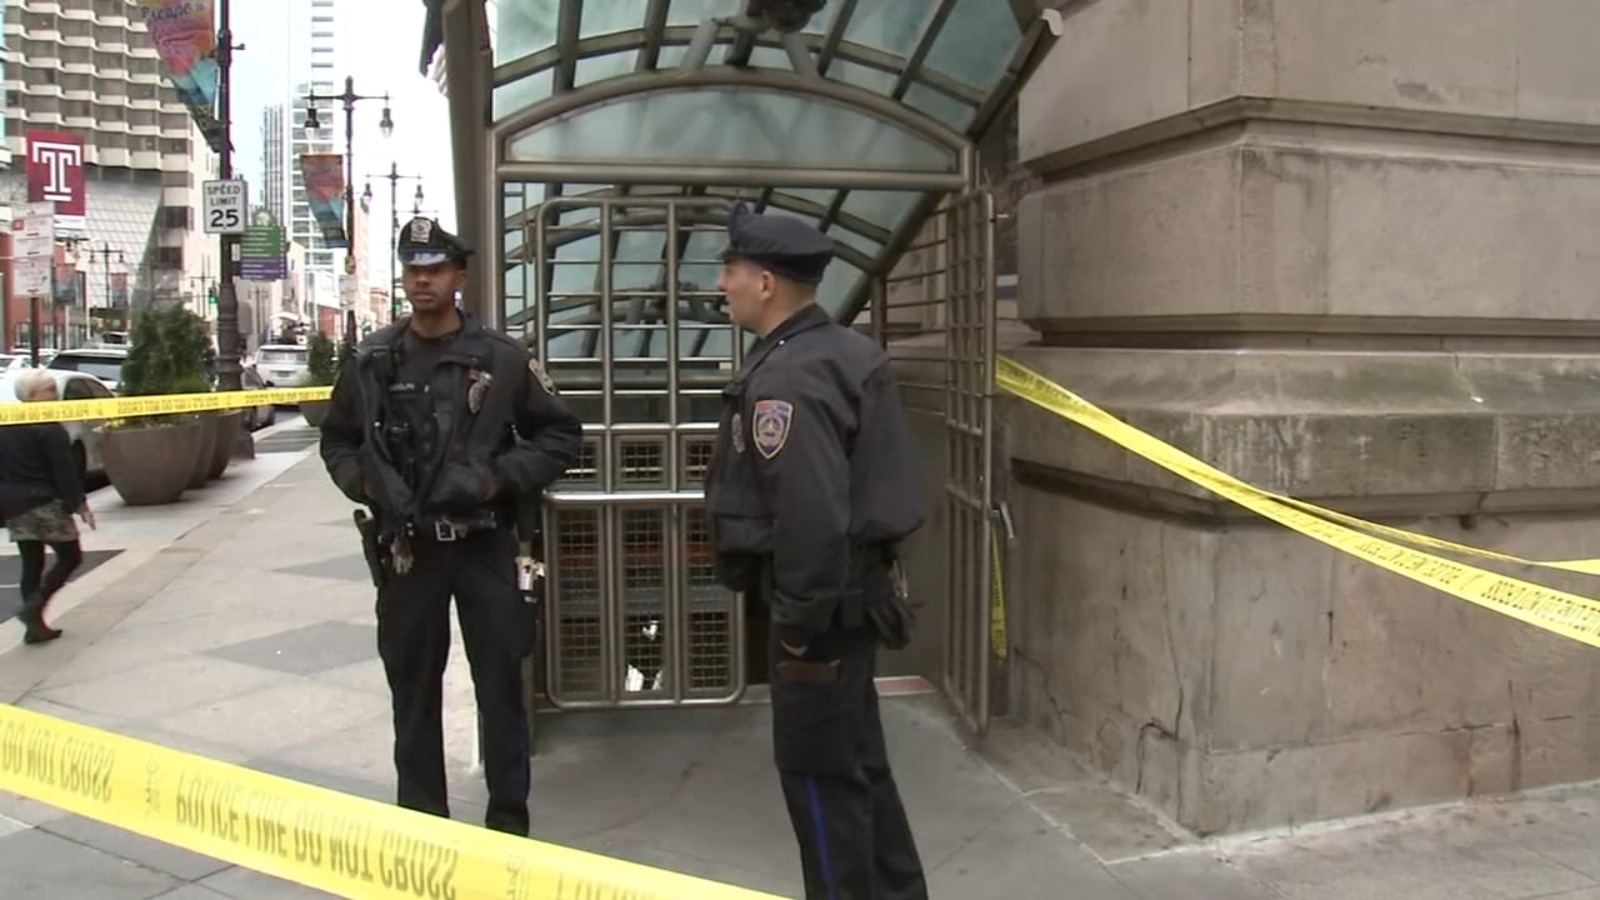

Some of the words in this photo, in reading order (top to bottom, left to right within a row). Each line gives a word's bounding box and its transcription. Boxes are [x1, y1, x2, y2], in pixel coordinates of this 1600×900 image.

[32, 141, 81, 201] T
[205, 182, 241, 195] SPEED
[209, 196, 238, 207] LIMIT
[210, 209, 240, 228] 25
